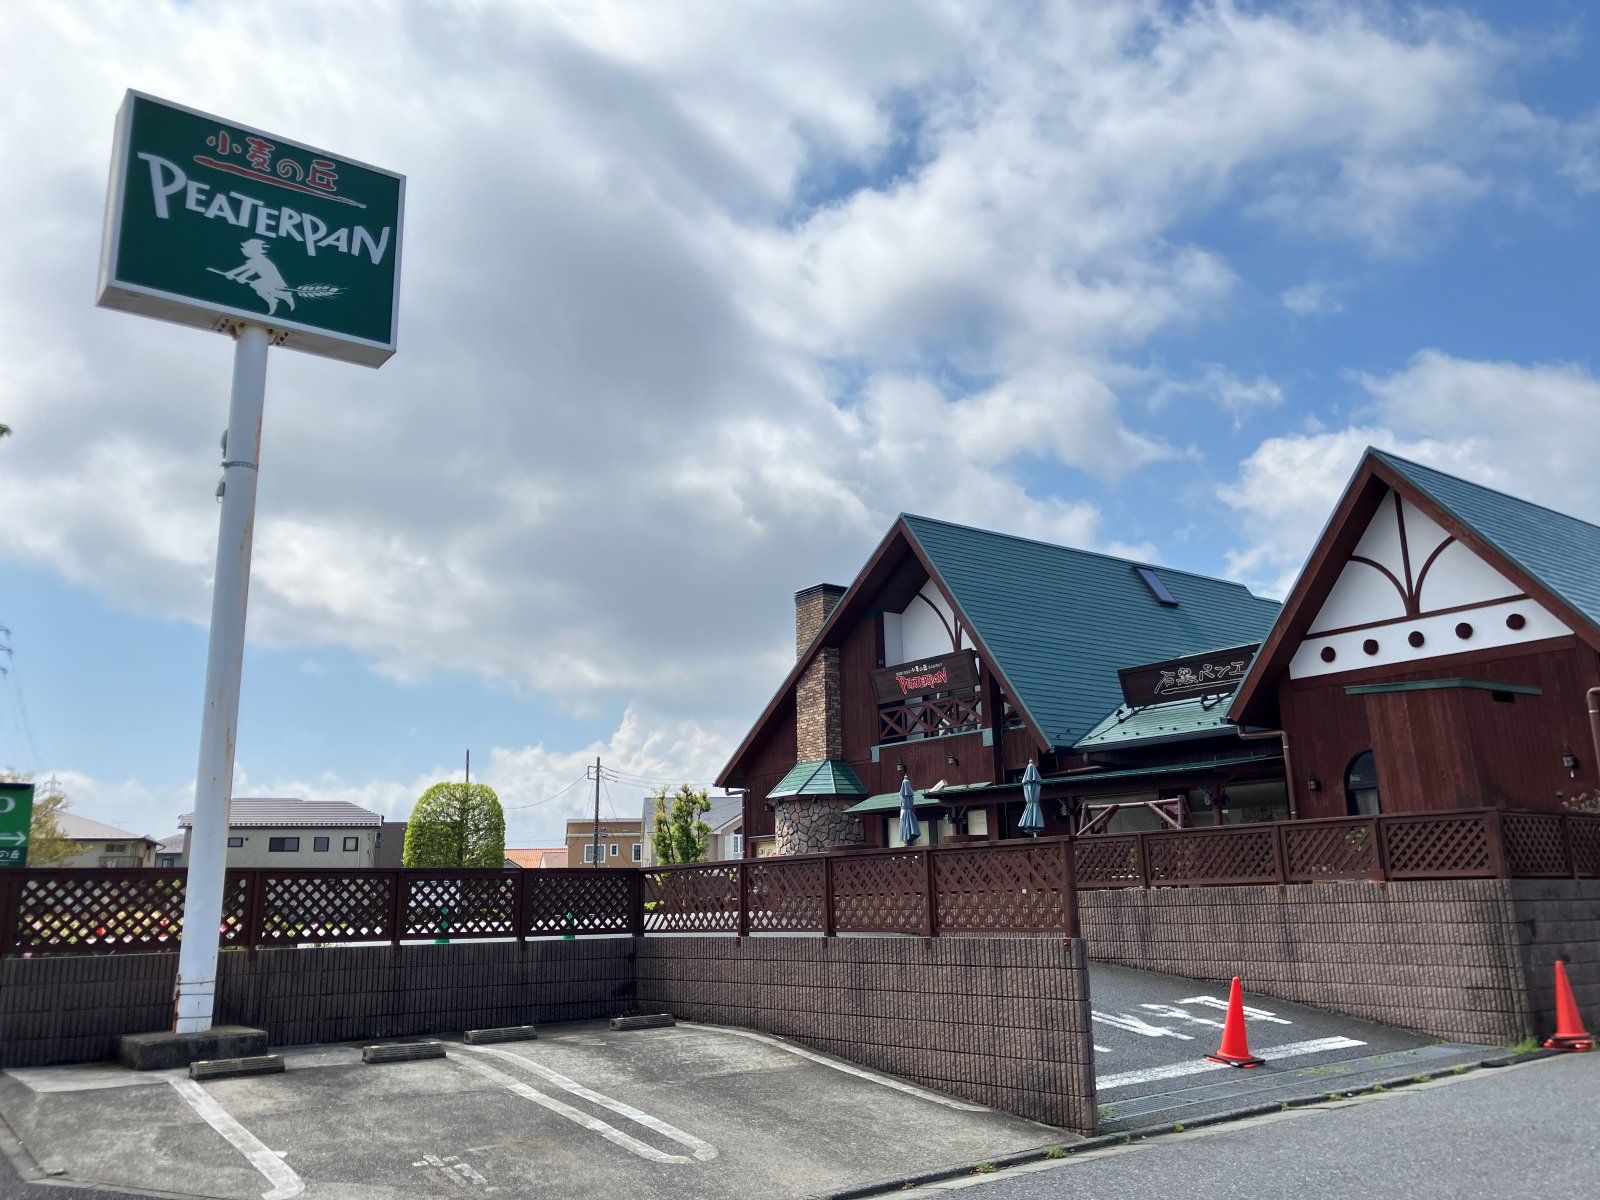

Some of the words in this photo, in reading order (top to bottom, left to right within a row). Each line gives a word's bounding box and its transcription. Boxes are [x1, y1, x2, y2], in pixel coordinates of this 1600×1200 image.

[206, 130, 338, 191] 小麦の丘
[137, 151, 391, 265] PEATERPAN
